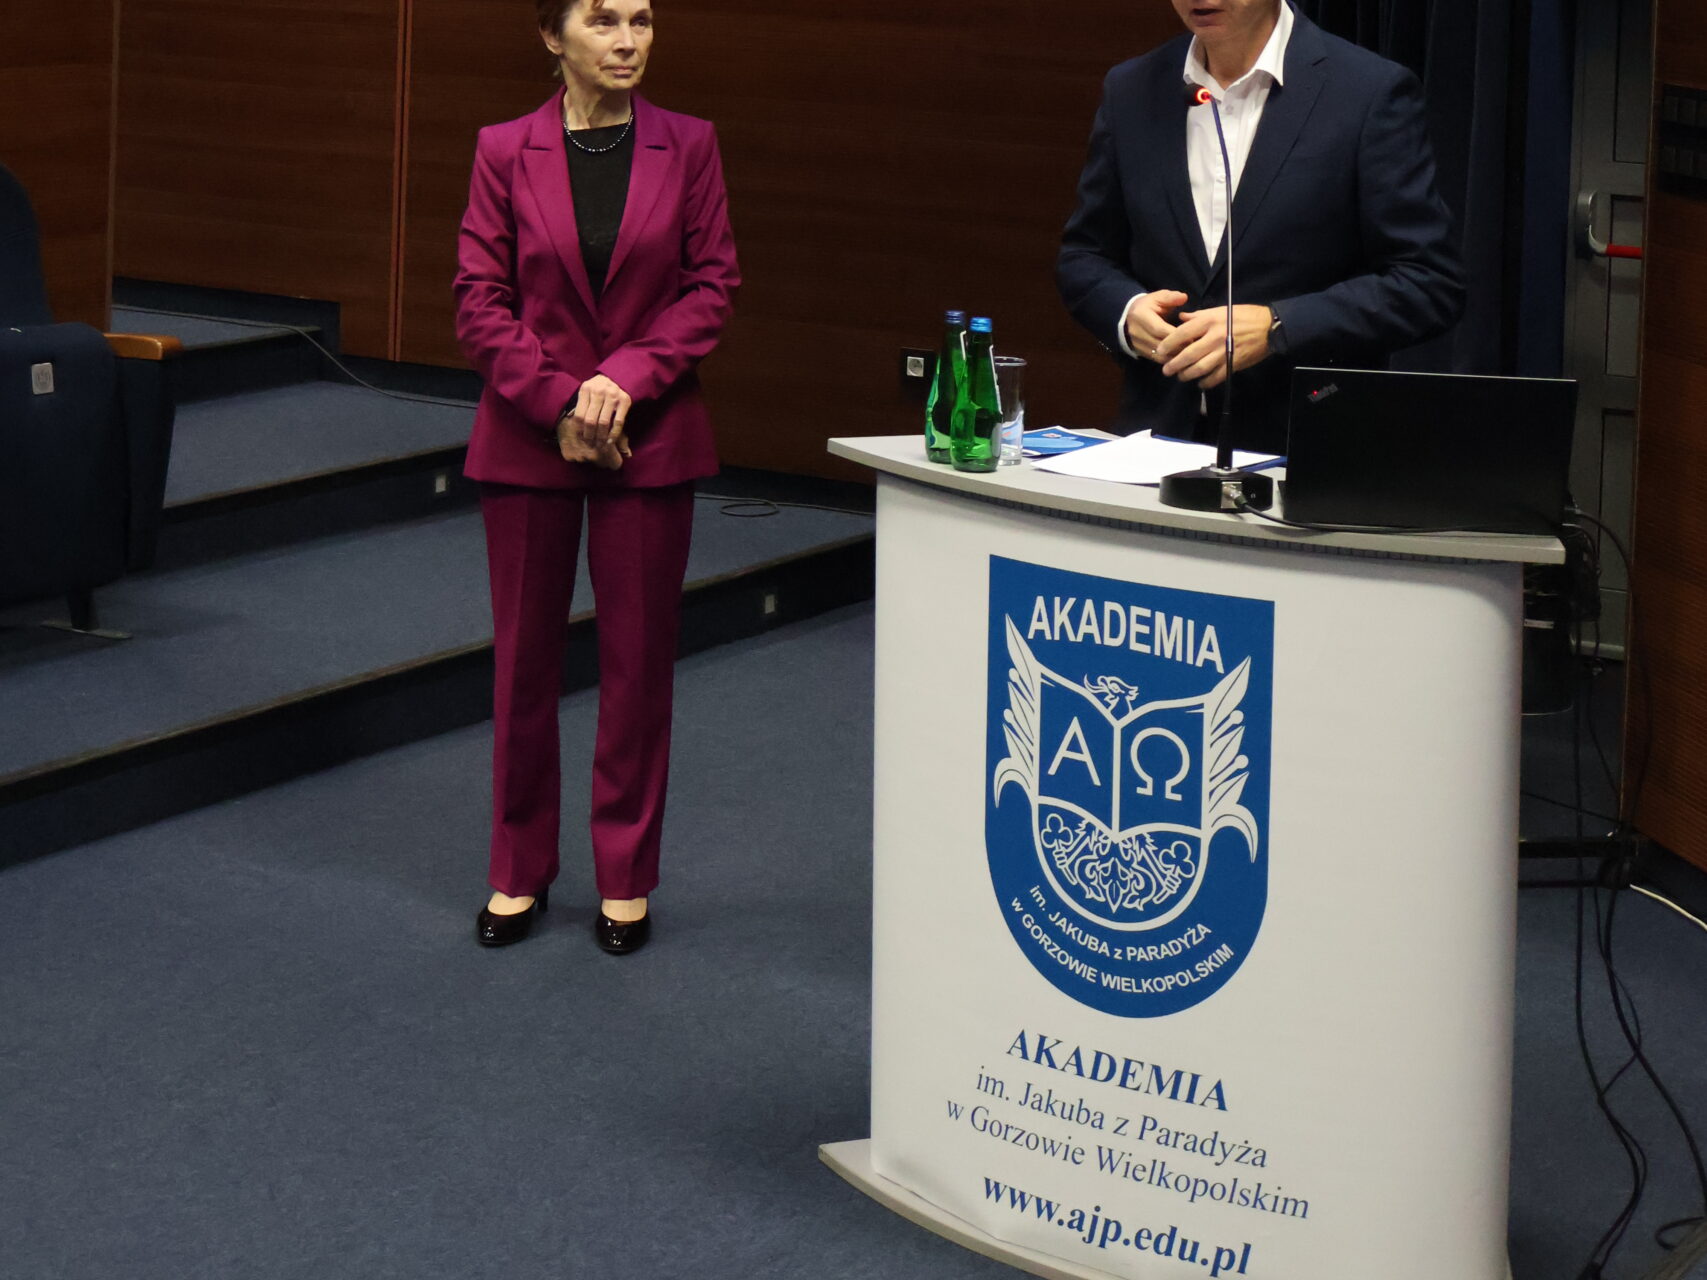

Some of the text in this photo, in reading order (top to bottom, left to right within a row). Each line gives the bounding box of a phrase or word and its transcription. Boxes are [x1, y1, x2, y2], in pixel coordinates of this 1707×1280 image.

[1027, 594, 1225, 674] AKADEMIA
[1011, 896, 1235, 993] w GORZOWIE WIELKOPOLSKIM
[1029, 884, 1212, 962] im. JAKUBA z PARADYŻA
[975, 1065, 1267, 1168] im. Jakuba z Paradyża
[1006, 1028, 1229, 1112] AKADEMIA
[947, 1100, 1309, 1219] w Gorzowie Wielkopolskim
[983, 1176, 1252, 1278] www.ajp.edu.pl
